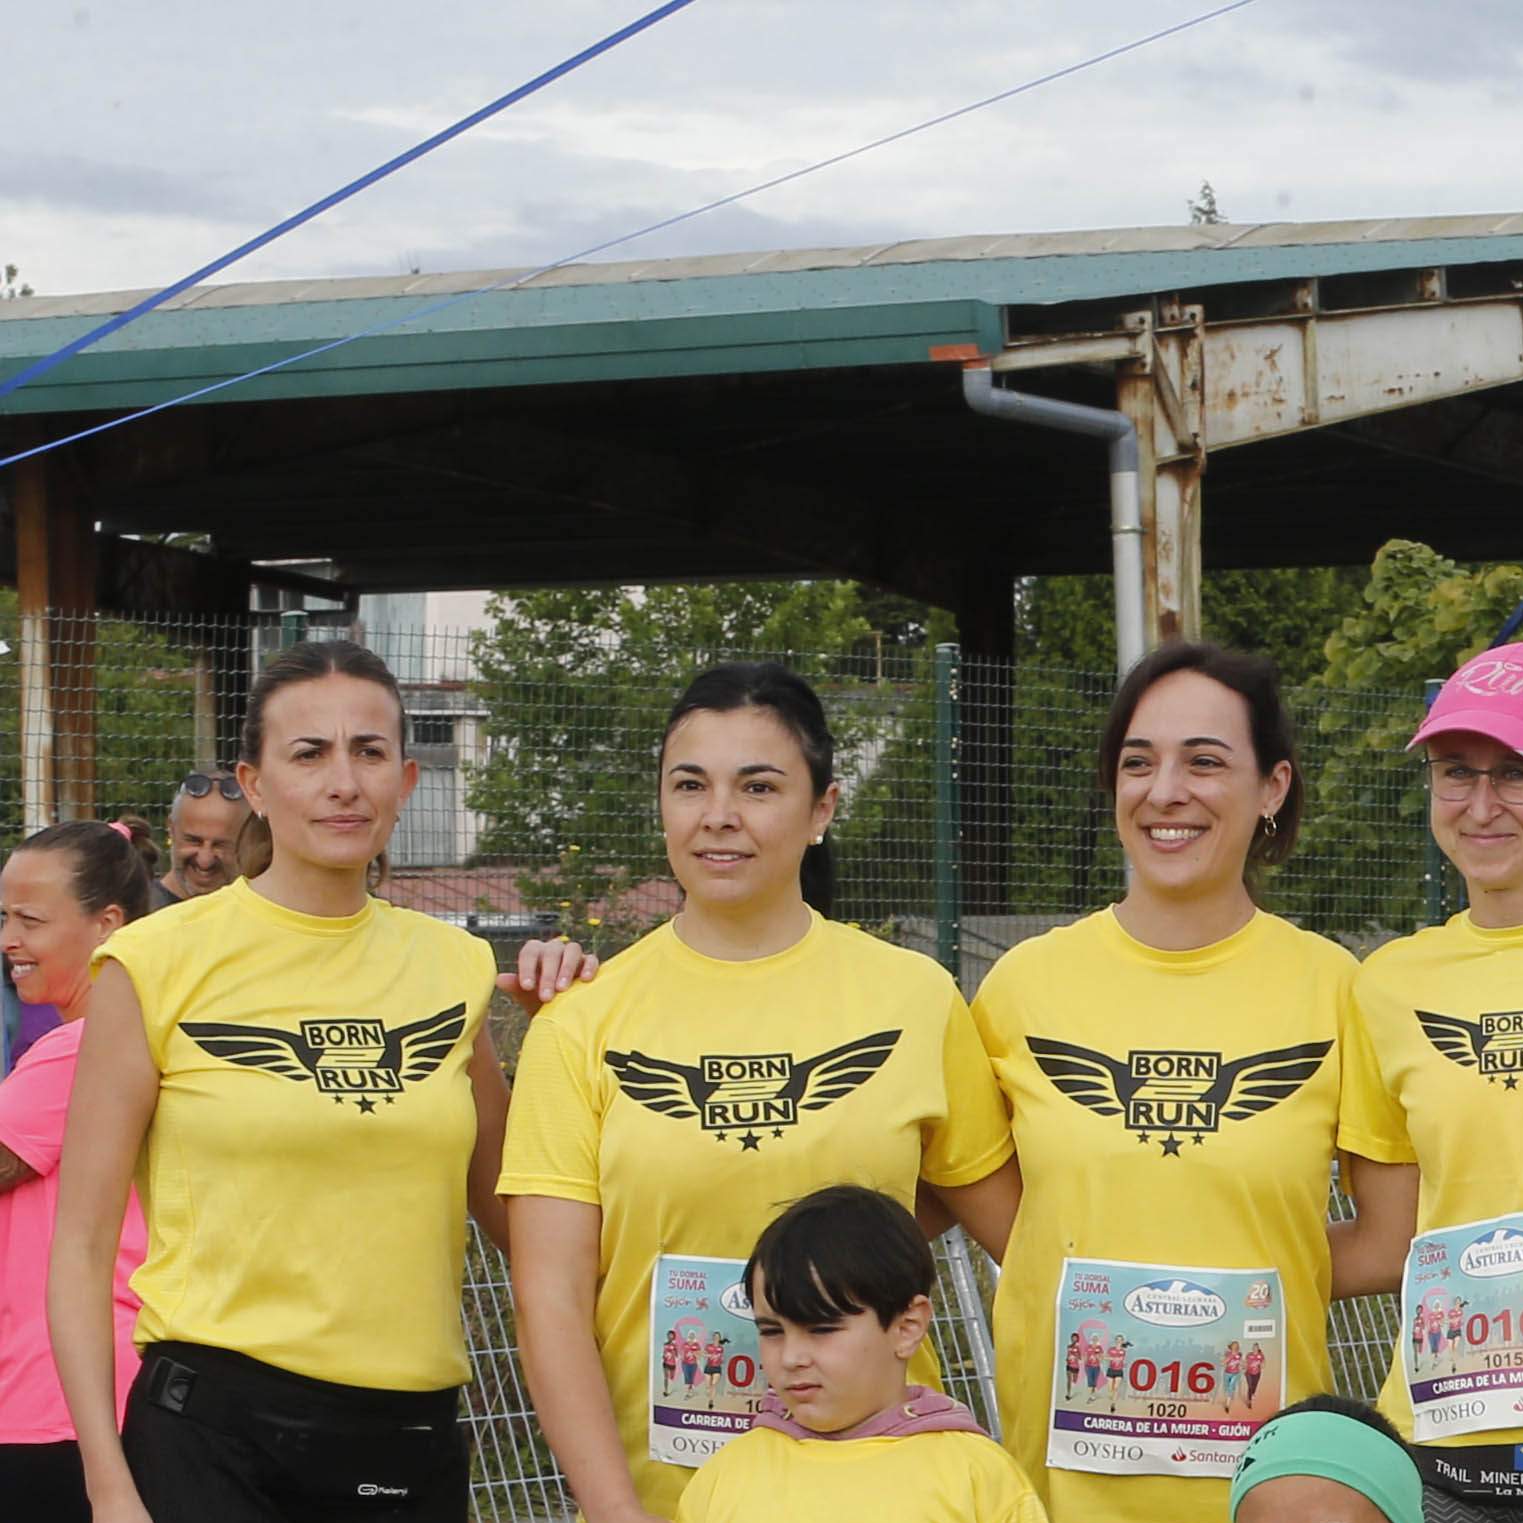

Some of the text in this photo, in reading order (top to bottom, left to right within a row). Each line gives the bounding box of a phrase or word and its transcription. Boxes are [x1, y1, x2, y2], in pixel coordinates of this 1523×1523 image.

[309, 1023, 381, 1047] BORN
[707, 1059, 788, 1081] BORN
[1135, 1056, 1215, 1077] BORN
[319, 1069, 397, 1089] RUN
[707, 1103, 791, 1124] RUN
[1132, 1102, 1215, 1127] RUN
[1417, 1250, 1448, 1267] SUMA
[668, 1278, 706, 1291] SUMA
[1073, 1281, 1110, 1295] SUMA
[1251, 1284, 1269, 1299] 20
[1130, 1295, 1220, 1318] ASTURIANA
[1483, 1352, 1523, 1369] 1015
[1129, 1359, 1216, 1394] 016
[1432, 1380, 1473, 1395] CARRERA
[1476, 1375, 1490, 1388] DE
[1492, 1374, 1507, 1386] LA
[1147, 1403, 1187, 1418] 1020
[1431, 1400, 1486, 1424] OYSHO
[681, 1413, 750, 1430] CARRERA DE
[1083, 1416, 1251, 1437] CARRERA DE LA MUJER GIJÓN
[1073, 1440, 1144, 1462] OYSHO
[1435, 1459, 1472, 1484] TRAIL
[1496, 1487, 1513, 1496] La
